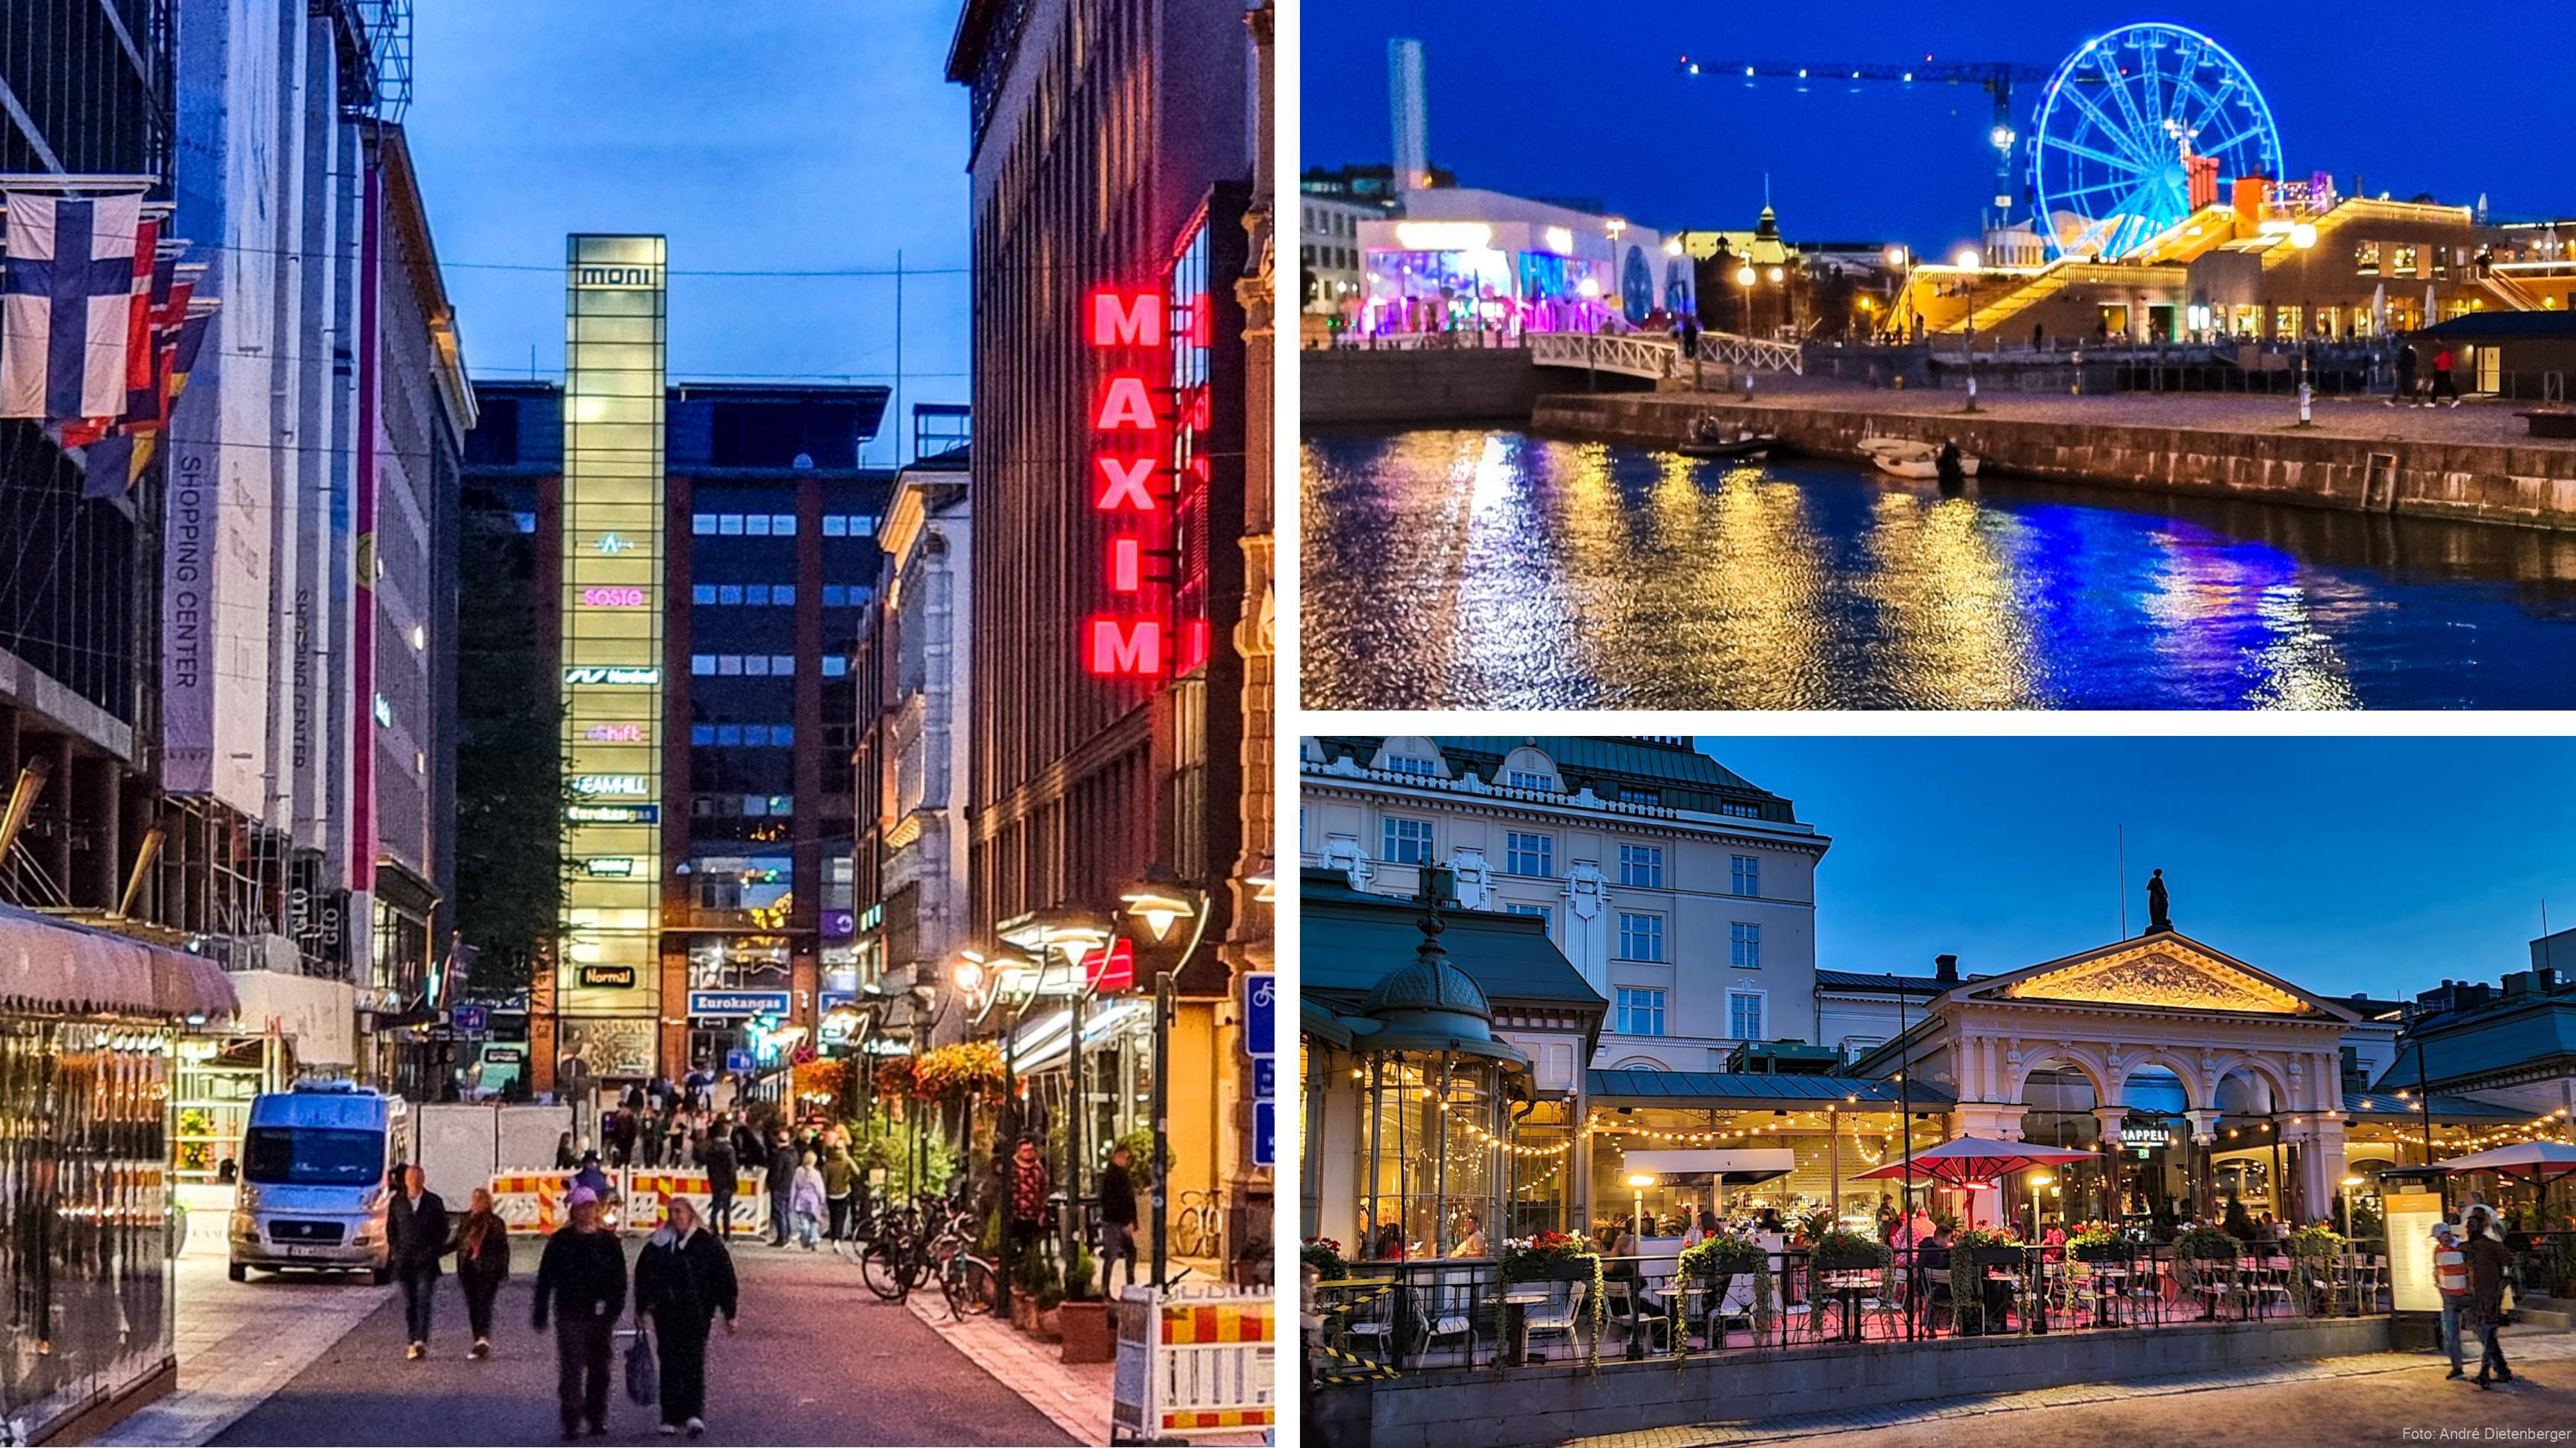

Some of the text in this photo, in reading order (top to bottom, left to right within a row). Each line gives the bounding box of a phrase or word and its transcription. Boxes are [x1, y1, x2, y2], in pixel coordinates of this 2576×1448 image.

[1093, 293, 1161, 675] MAXIM
[175, 456, 201, 689] SHOPPING CENTER
[586, 969, 631, 984] Normal
[697, 996, 781, 1010] Eurokangas
